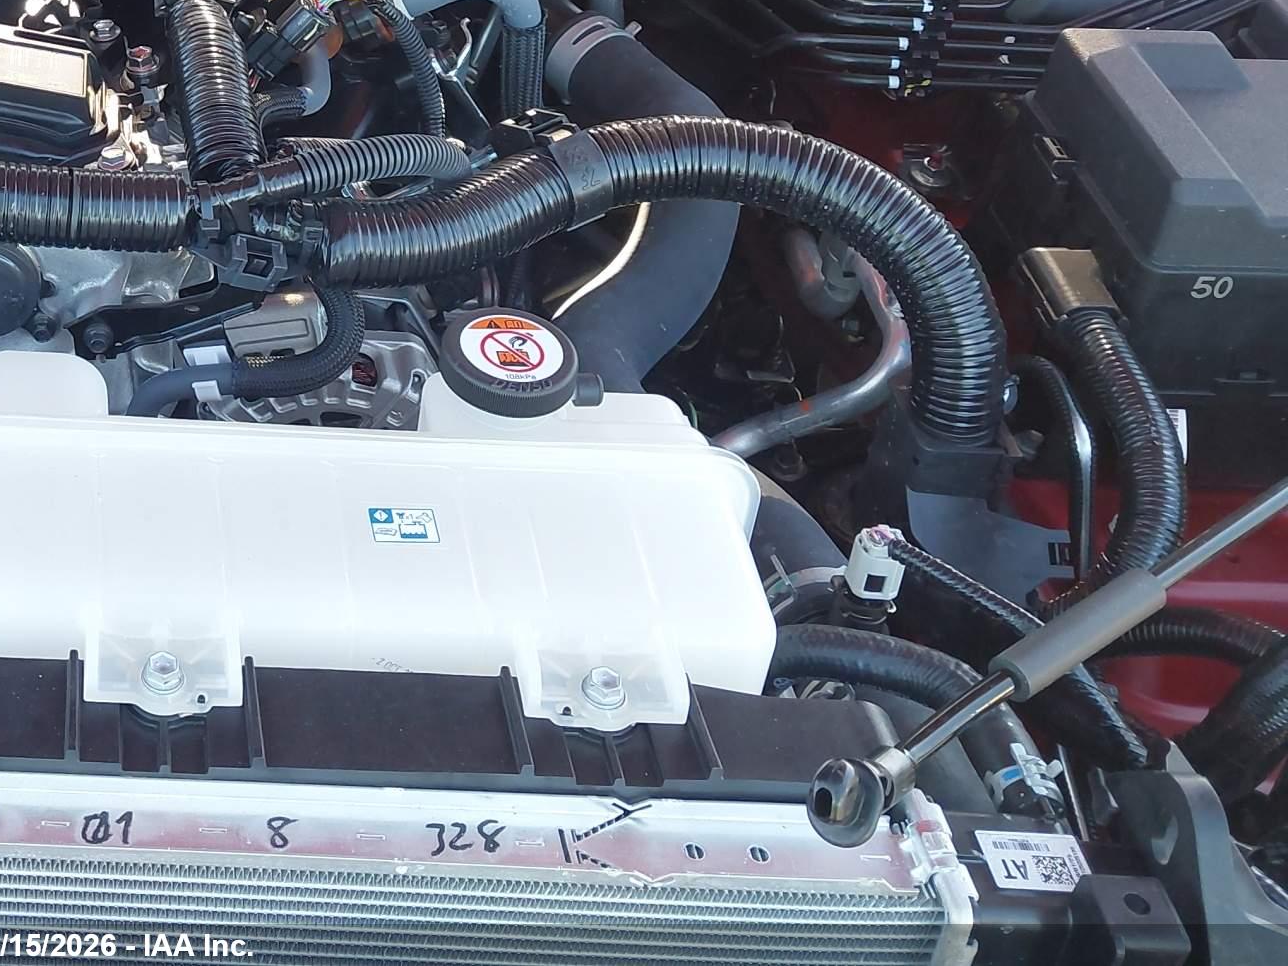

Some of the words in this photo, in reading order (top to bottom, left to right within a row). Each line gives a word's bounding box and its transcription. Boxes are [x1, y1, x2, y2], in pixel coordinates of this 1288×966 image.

[1190, 276, 1234, 299] 50
[492, 379, 553, 393] DENSO
[267, 816, 299, 849] 8
[425, 819, 507, 857] 328
[1001, 859, 1029, 880] AT
